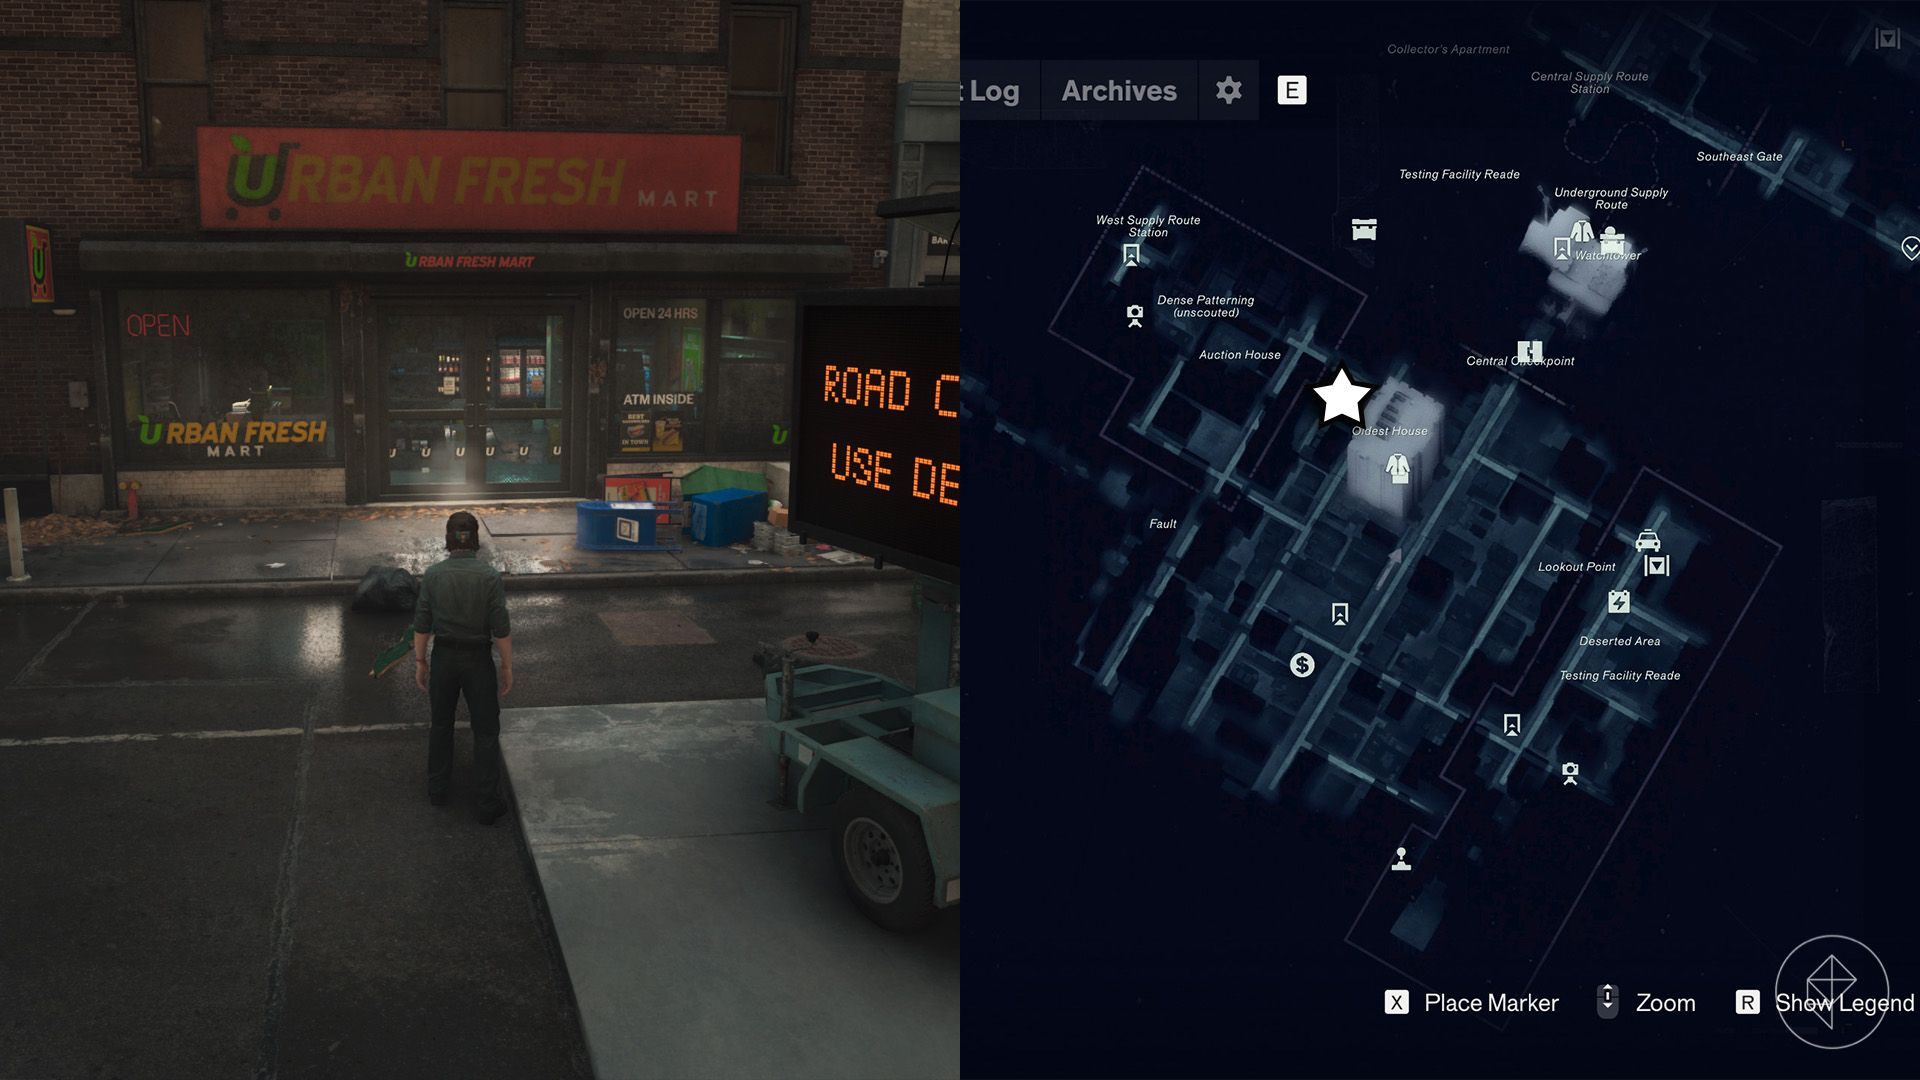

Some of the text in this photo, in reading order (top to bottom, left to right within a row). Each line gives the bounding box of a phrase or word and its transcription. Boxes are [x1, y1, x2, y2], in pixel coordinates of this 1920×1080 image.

[1387, 45, 1510, 55] Collector's Apartment
[1530, 71, 1649, 84] Central Supply Route
[971, 79, 1020, 107] Log
[1061, 79, 1178, 102] Archives
[1570, 84, 1610, 95] Station
[1696, 152, 1783, 162] Southeast Gate
[227, 135, 719, 208] URBAN FRESH MART
[1399, 169, 1521, 181] Testing Facility Reade
[1554, 187, 1669, 199] Underground Supply
[1594, 200, 1629, 209] Route
[1096, 215, 1201, 227] West Supply Route
[1128, 227, 1168, 238] Station
[932, 236, 956, 244] BAN
[405, 252, 534, 268] URBAN FRESH MART
[1157, 295, 1255, 308] Dense Patterning
[623, 307, 698, 319] OPEN 24 HRS
[1173, 308, 1240, 318] (unscouted)
[127, 313, 190, 336] OPEN
[1198, 350, 1281, 359] Auction House
[1466, 356, 1509, 366] Central
[825, 365, 960, 418] ROAD C
[623, 393, 694, 405] ATM INSIDE
[138, 415, 327, 444] URBAN FRESH
[1391, 425, 1429, 436] House
[207, 445, 264, 457] MART
[832, 443, 960, 507] USE DE
[1149, 519, 1177, 528] Fault
[1538, 562, 1616, 571] Lookout Point
[1580, 636, 1661, 646] Deserted Area
[1560, 670, 1681, 683] Testing Facility Reade
[1425, 994, 1560, 1011] Place Marker
[1636, 994, 1696, 1011] Zoom
[1776, 992, 1915, 1017] Show Legend
